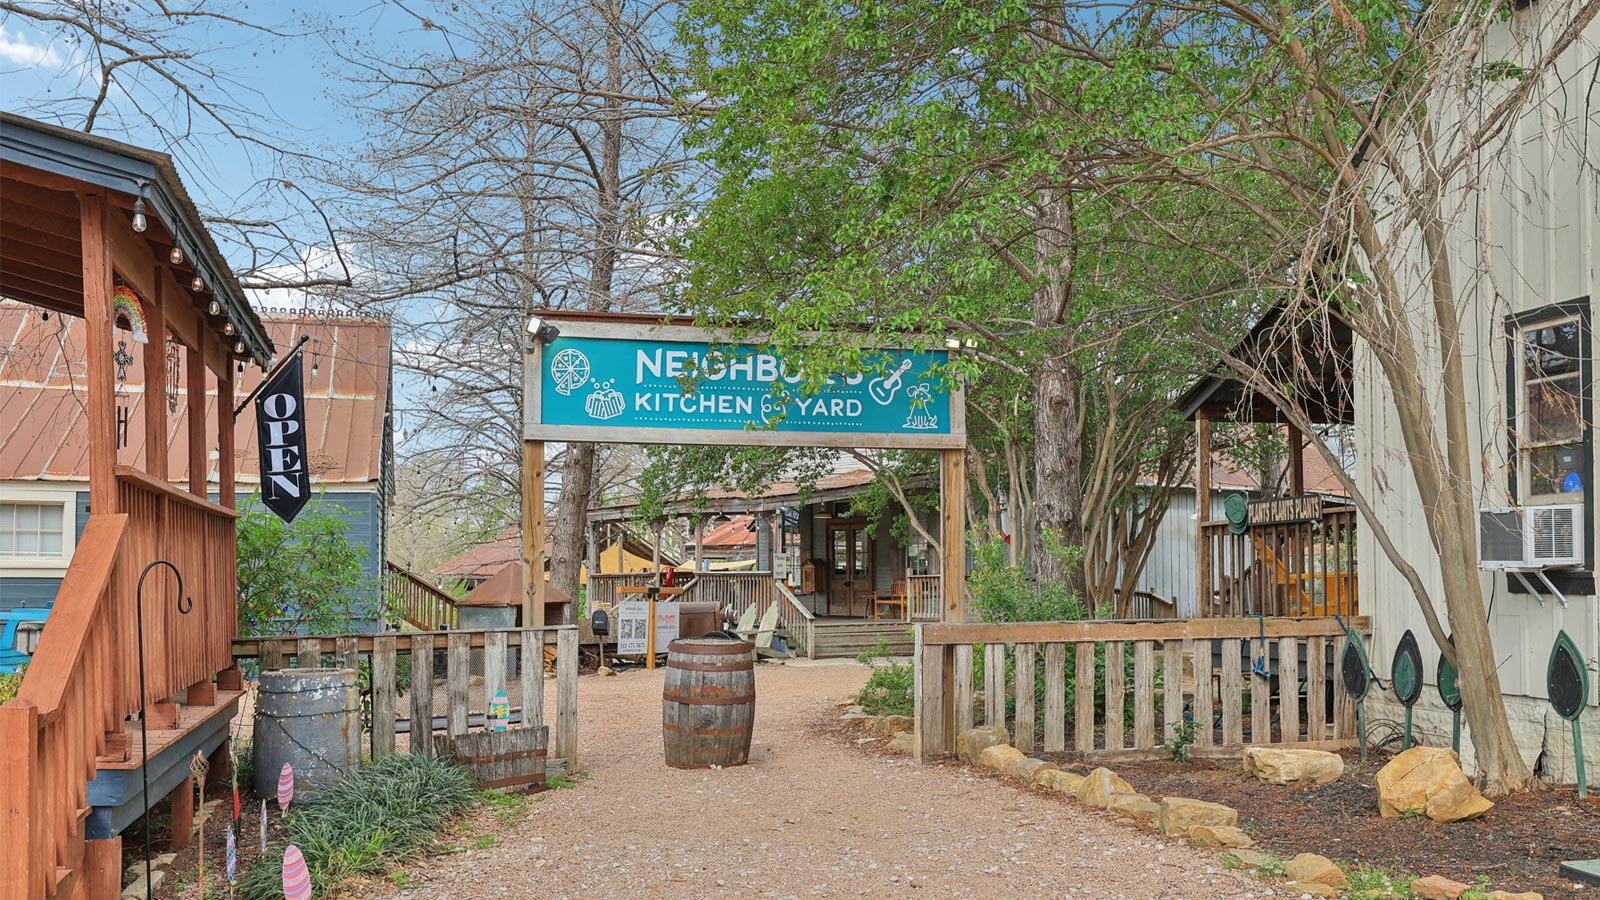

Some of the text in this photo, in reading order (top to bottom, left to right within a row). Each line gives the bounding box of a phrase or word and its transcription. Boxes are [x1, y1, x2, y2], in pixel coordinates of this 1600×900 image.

[635, 392, 753, 415] KITCHEN
[795, 397, 863, 417] YARD
[263, 393, 304, 500] OPEN
[1248, 496, 1320, 524] PLANTS PLANTS PLANTS
